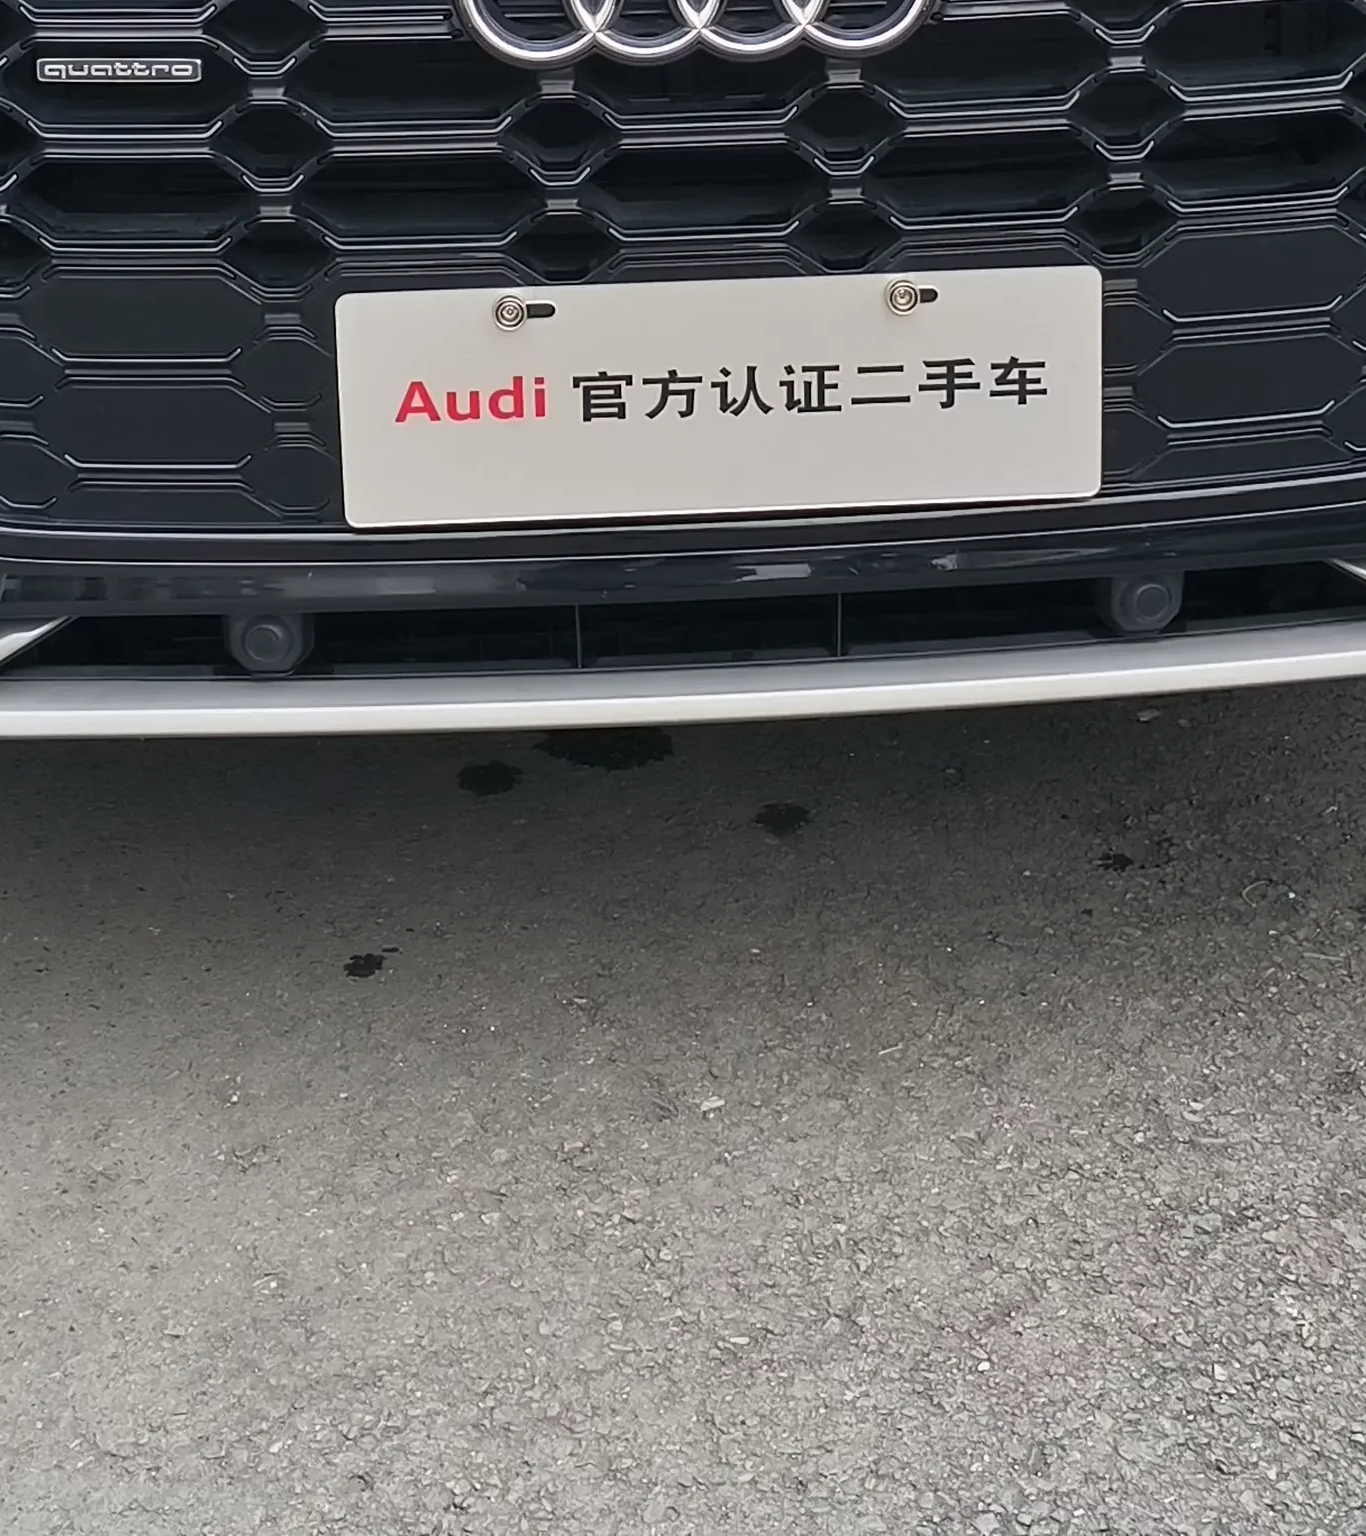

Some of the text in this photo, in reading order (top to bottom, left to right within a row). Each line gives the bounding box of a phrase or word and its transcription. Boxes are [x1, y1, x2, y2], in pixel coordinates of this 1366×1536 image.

[44, 62, 194, 79] quattro
[395, 355, 1048, 425] Audi 官方认证二手车
